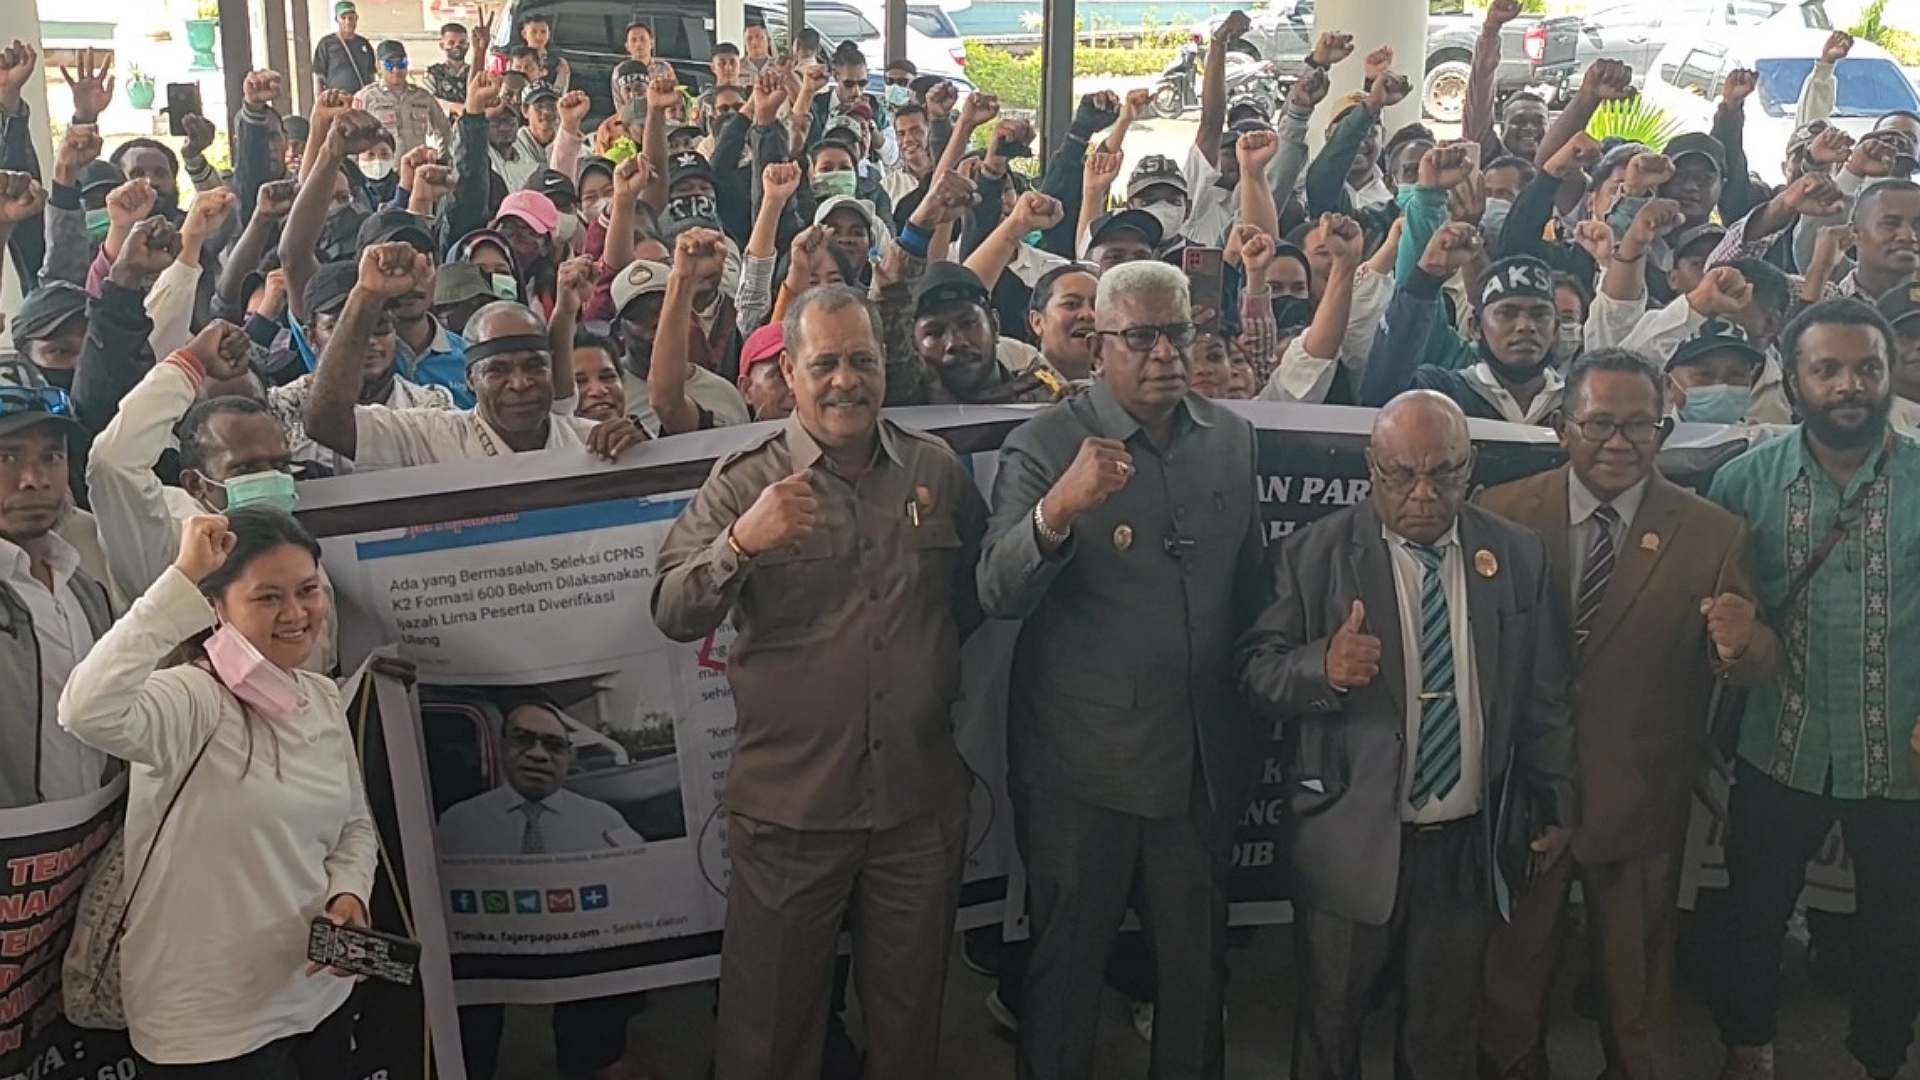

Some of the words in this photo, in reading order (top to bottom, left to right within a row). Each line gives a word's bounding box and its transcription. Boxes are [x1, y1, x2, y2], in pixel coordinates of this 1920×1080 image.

[1299, 477, 1371, 505] PAR
[389, 576, 419, 592] Ada
[421, 573, 458, 592] yang
[459, 560, 548, 583] Bermasalah,
[550, 551, 600, 571] Seleksi
[603, 546, 645, 562] CPNS
[392, 597, 412, 611] K2
[415, 588, 474, 609] Formasi
[477, 584, 505, 601] 600
[508, 581, 553, 597] Belum
[556, 567, 652, 590] Dilaksanakan,
[441, 610, 478, 626] Lima
[480, 602, 535, 620] Peserta
[538, 590, 615, 612] Diverifikasi
[453, 929, 496, 943] Timika,
[500, 927, 600, 945] fajarpapua.com
[612, 920, 654, 935] Seleksi
